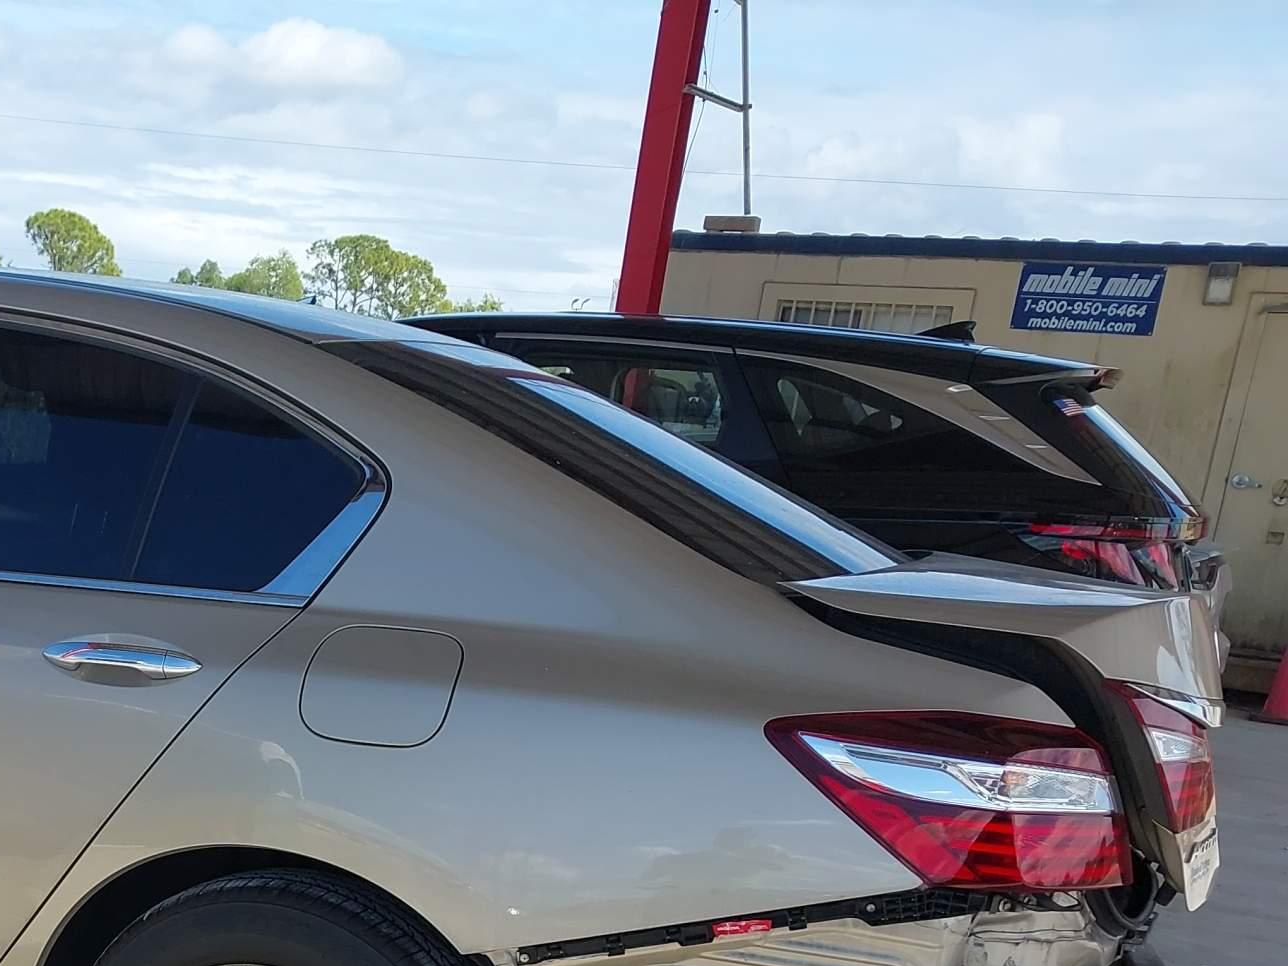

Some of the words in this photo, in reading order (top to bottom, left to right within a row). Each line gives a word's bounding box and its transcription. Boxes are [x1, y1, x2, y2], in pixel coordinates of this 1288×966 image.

[1022, 266, 1102, 295] mobile
[1101, 273, 1160, 297] mini
[1023, 299, 1147, 318] 1-800-950-6464
[1028, 317, 1137, 333] mobilemini.com
